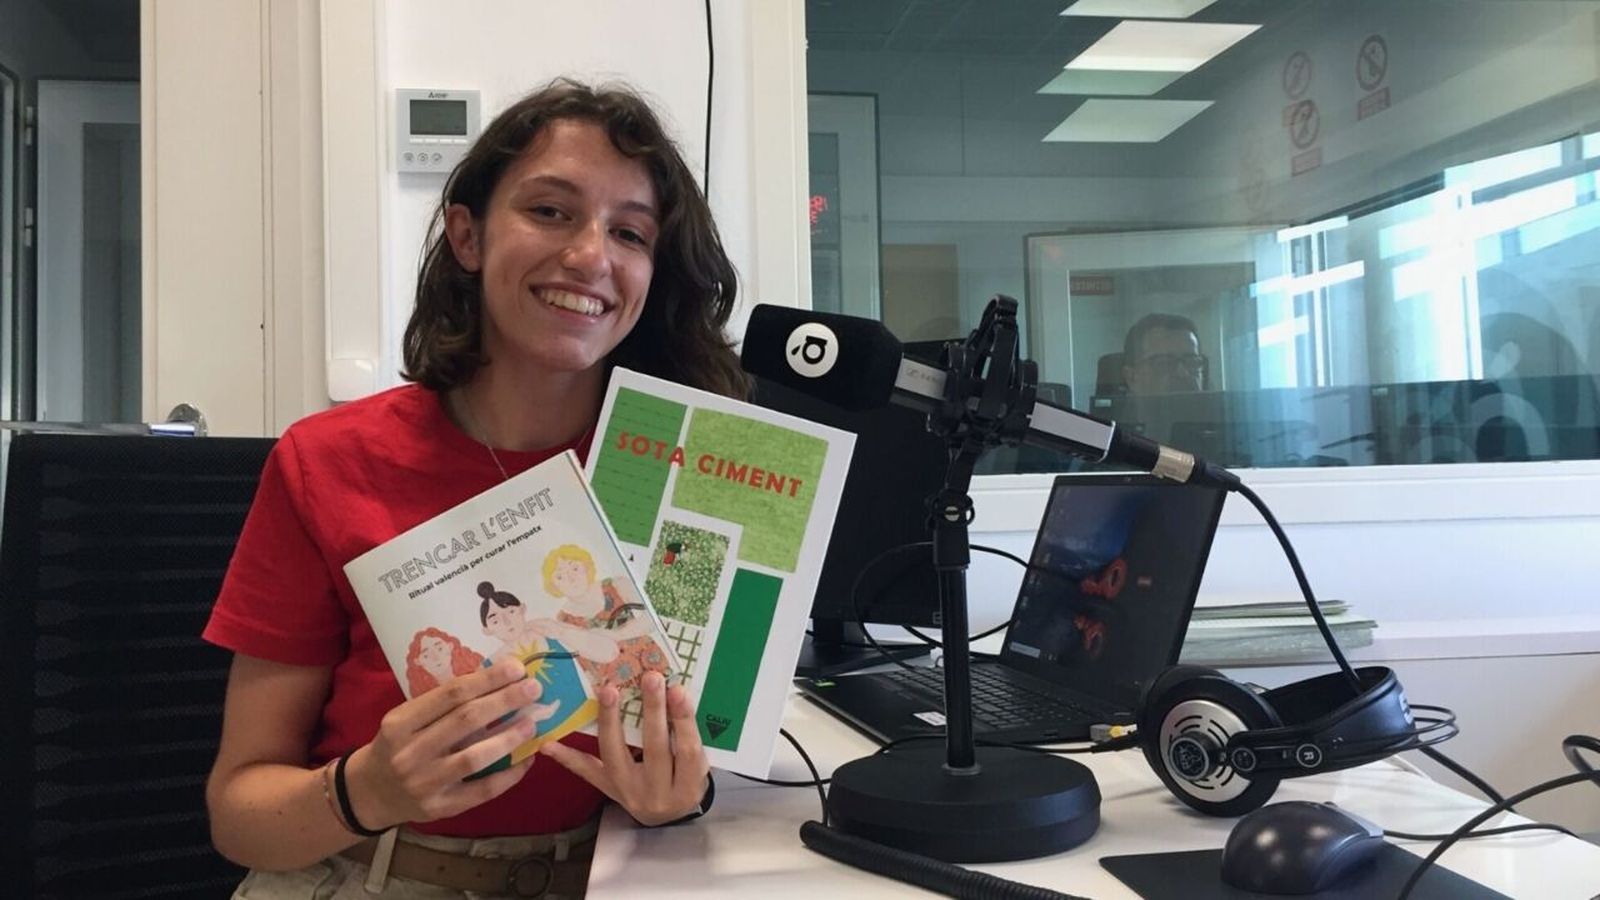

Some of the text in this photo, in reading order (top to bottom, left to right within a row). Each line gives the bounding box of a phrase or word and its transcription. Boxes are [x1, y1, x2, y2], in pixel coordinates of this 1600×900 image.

[617, 431, 803, 497] SOTA CIMENT
[377, 487, 554, 593] TRENCAR L'ENFIT
[408, 581, 435, 599] Ritual
[434, 564, 470, 586] valencià
[470, 556, 484, 569] per
[485, 543, 506, 559] curar
[1303, 751, 1315, 761] R
